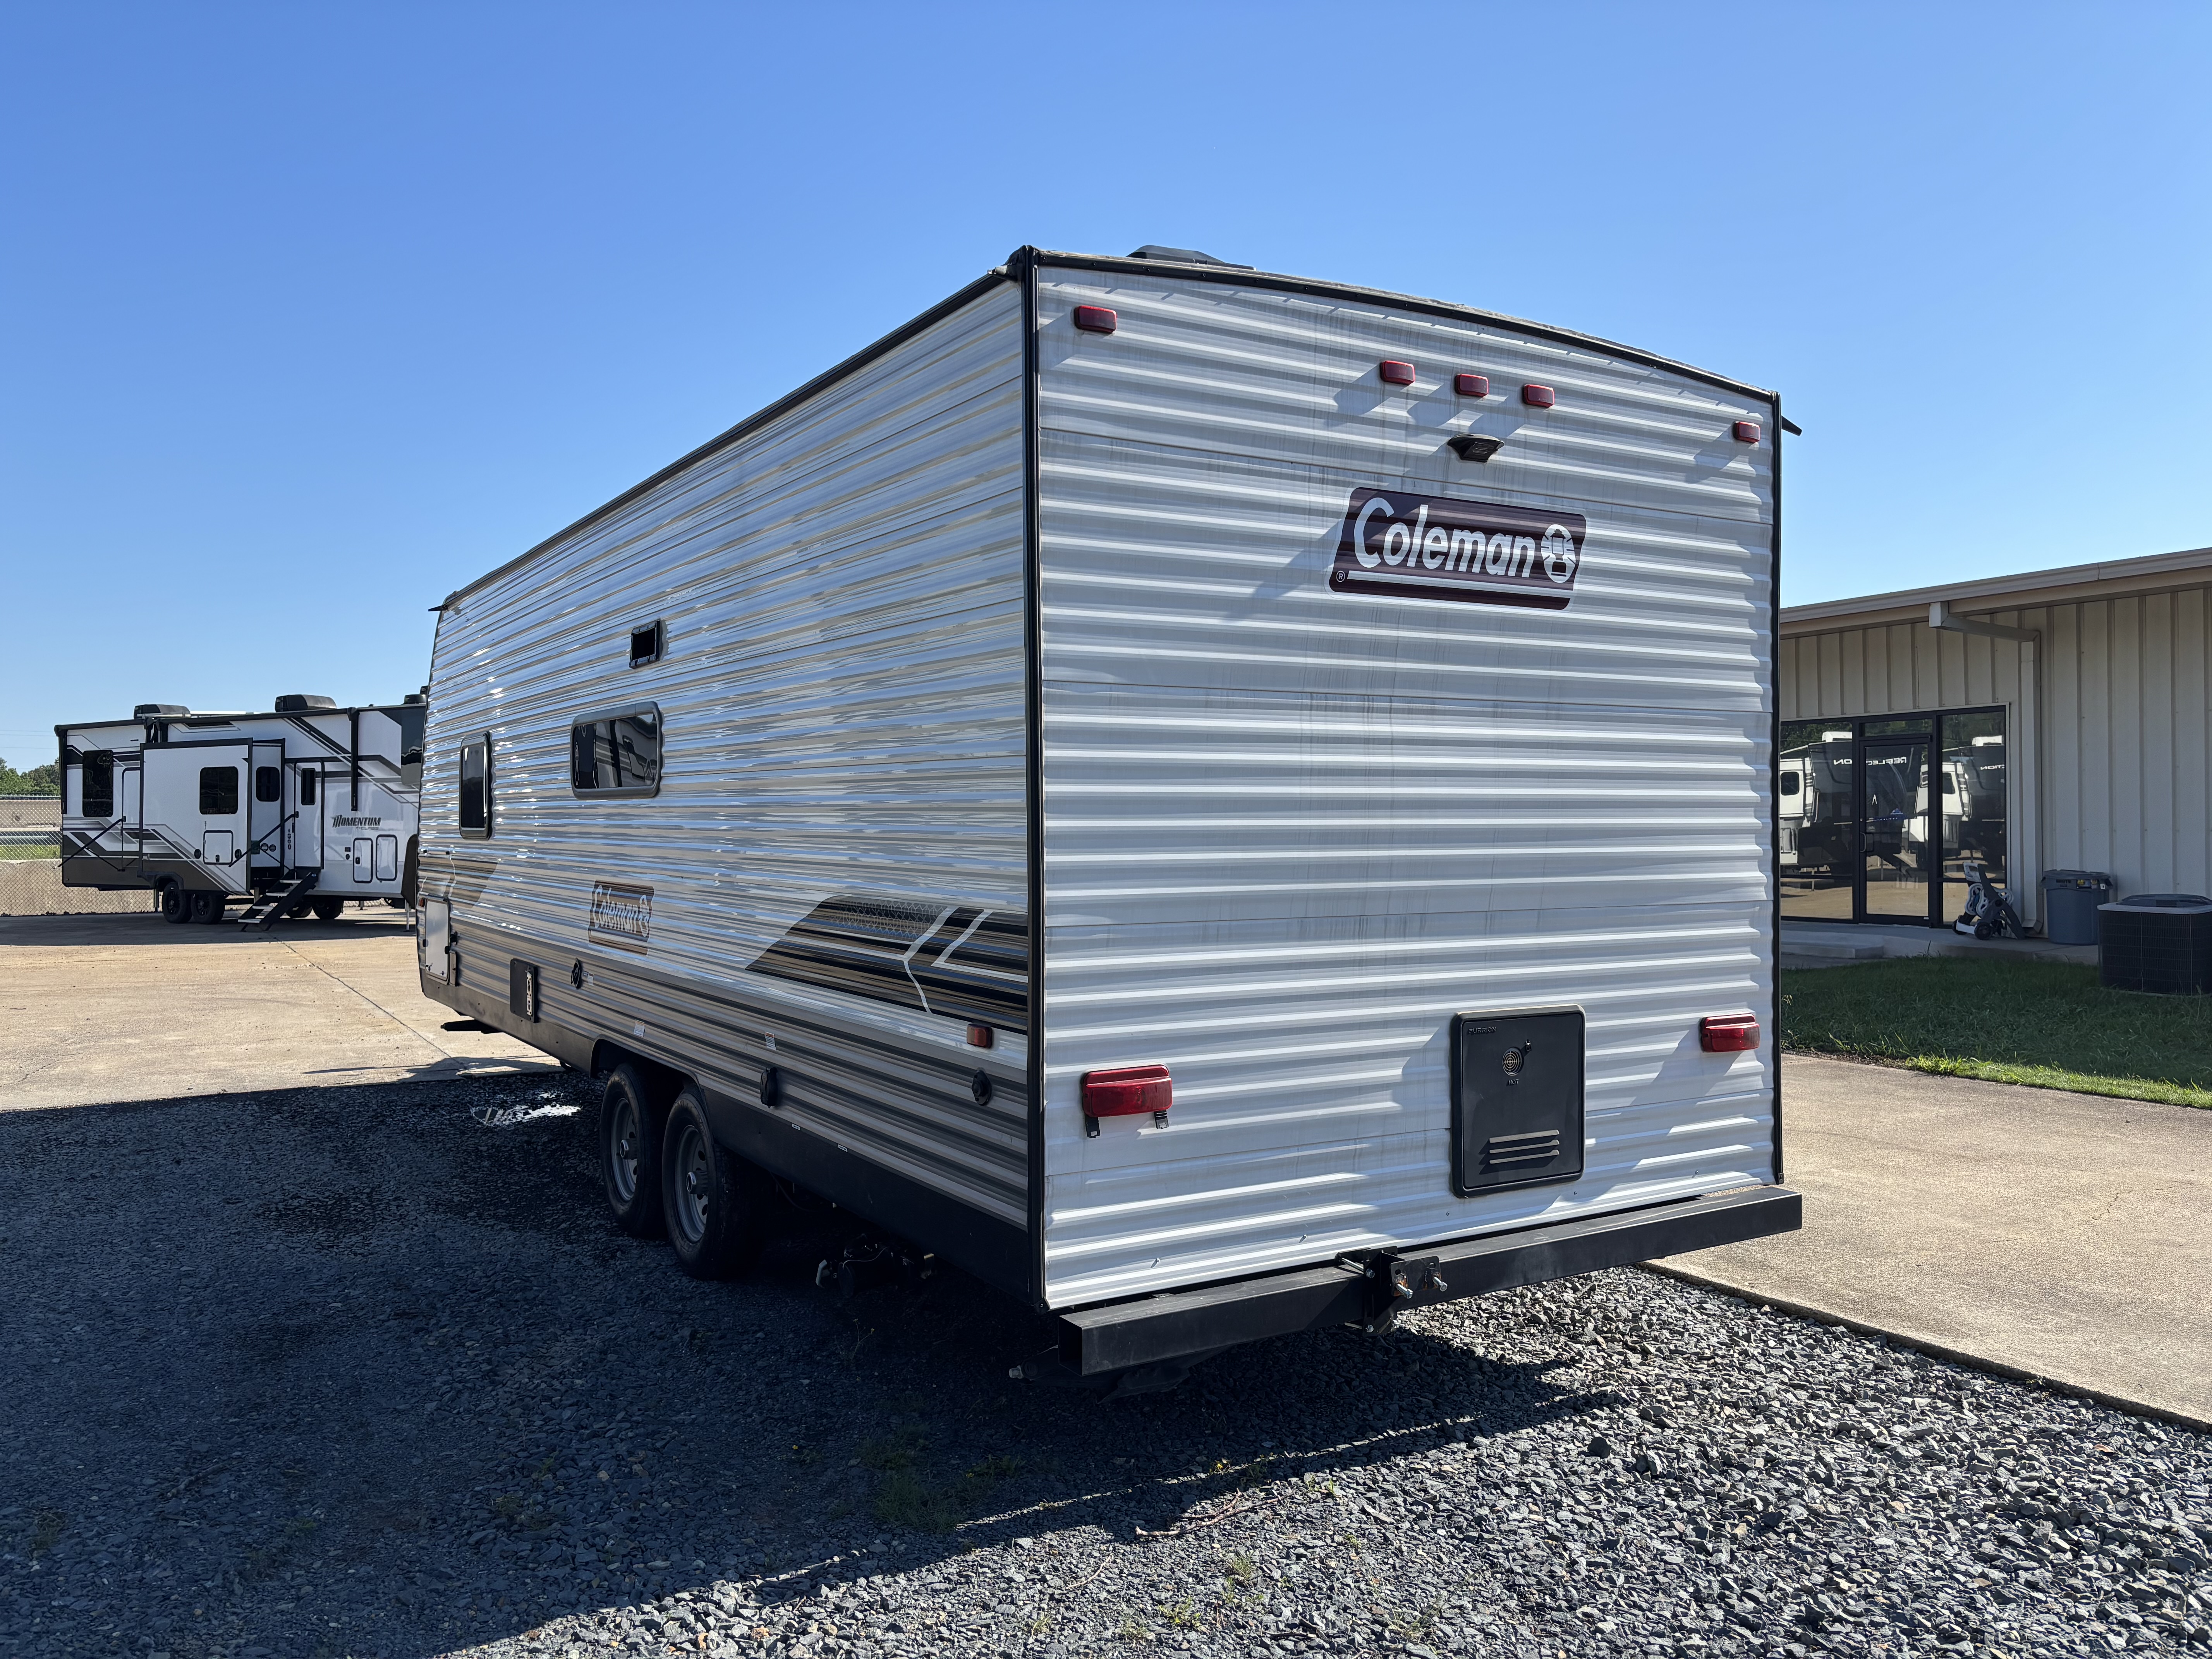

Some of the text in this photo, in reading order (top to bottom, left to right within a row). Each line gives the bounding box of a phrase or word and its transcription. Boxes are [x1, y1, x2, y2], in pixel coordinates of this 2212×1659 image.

[1354, 497, 1535, 578] Coleman
[331, 814, 381, 828] MOMENTUM
[592, 885, 639, 934] Coleman
